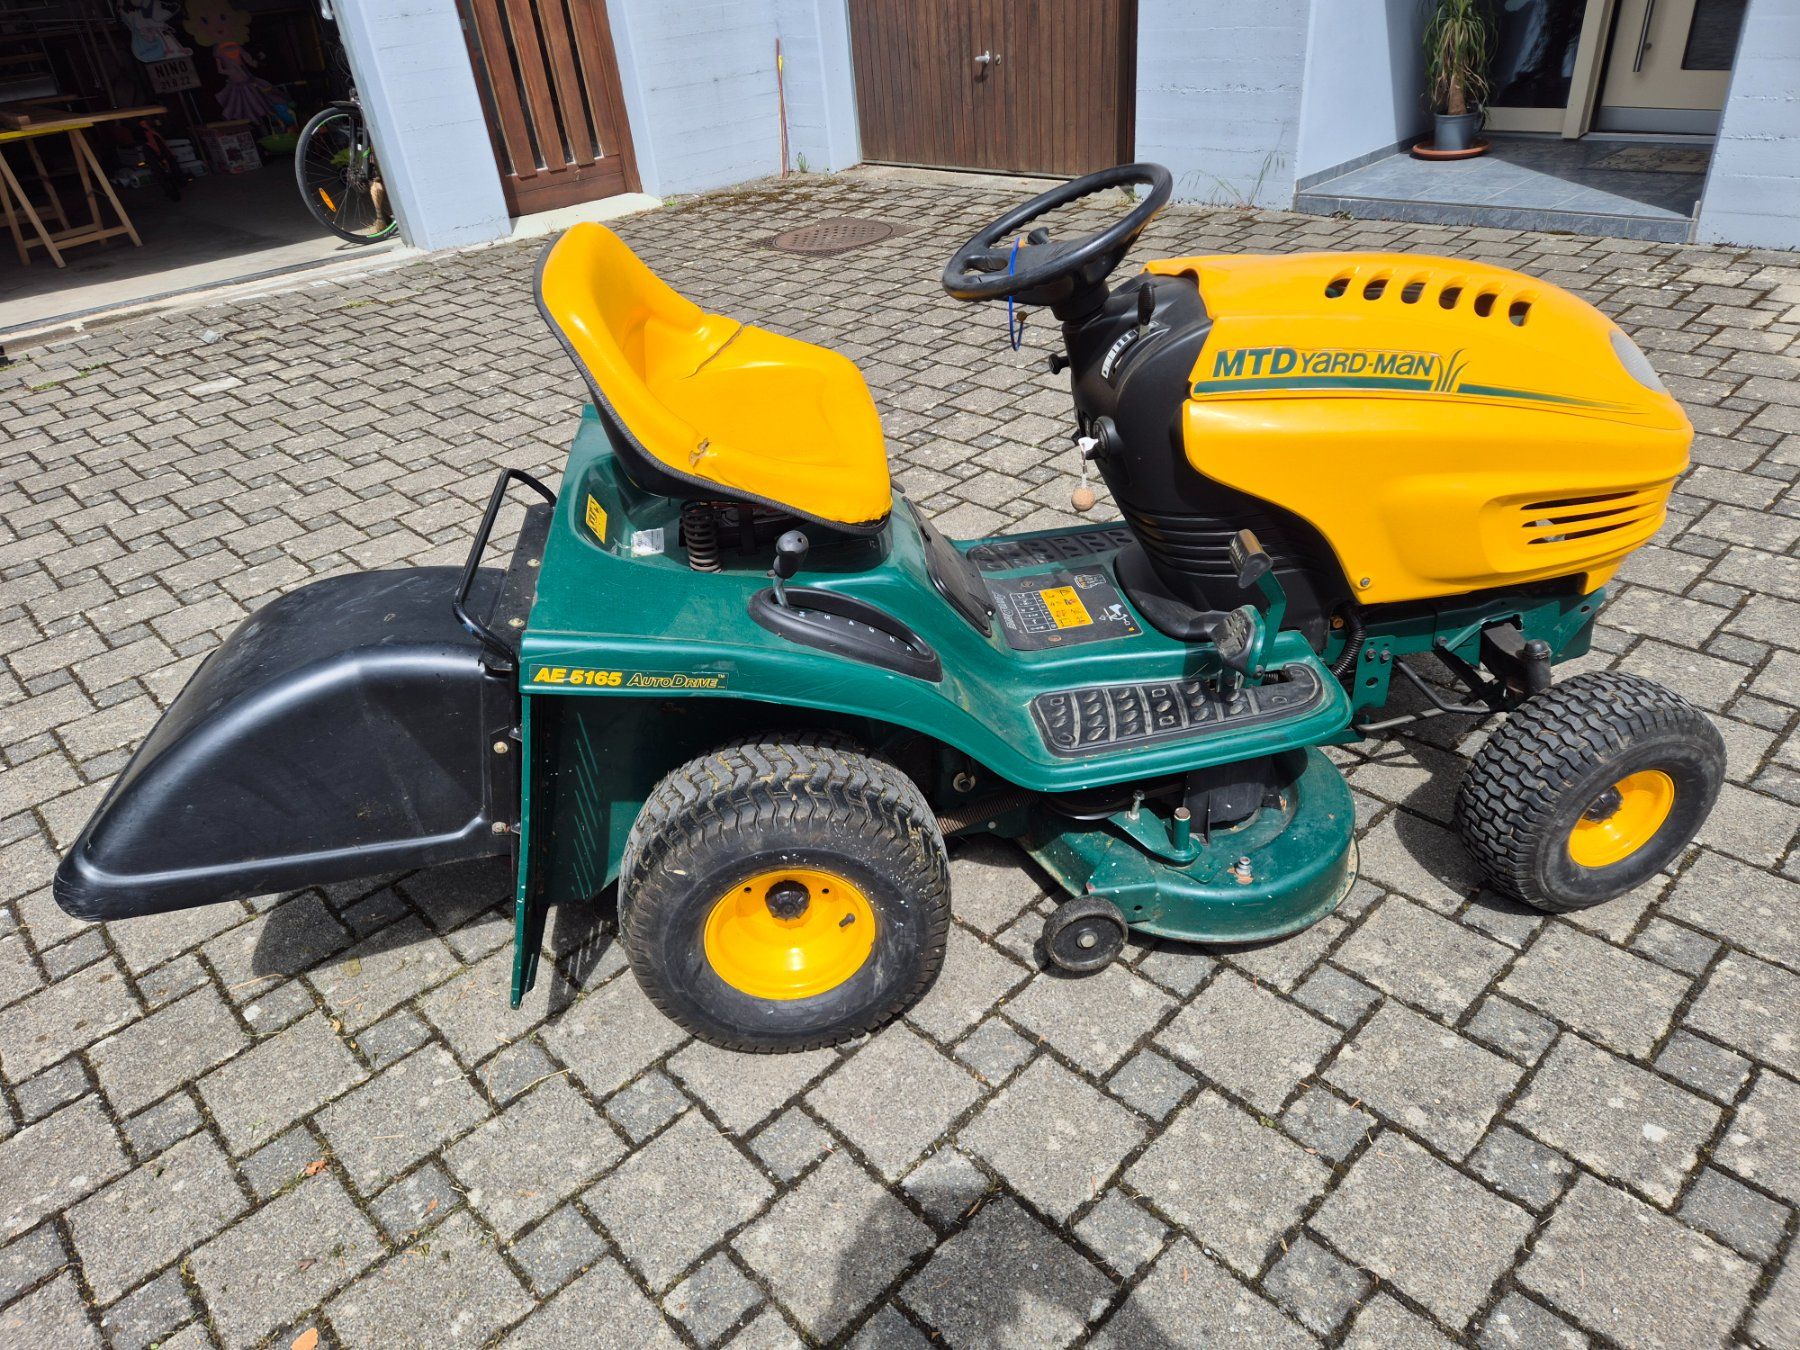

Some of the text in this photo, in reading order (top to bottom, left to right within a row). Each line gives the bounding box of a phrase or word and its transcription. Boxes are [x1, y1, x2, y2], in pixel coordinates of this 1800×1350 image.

[154, 61, 188, 78] NINO
[1212, 347, 1298, 378] MTD
[533, 667, 566, 683] AE
[569, 669, 622, 686] 5165
